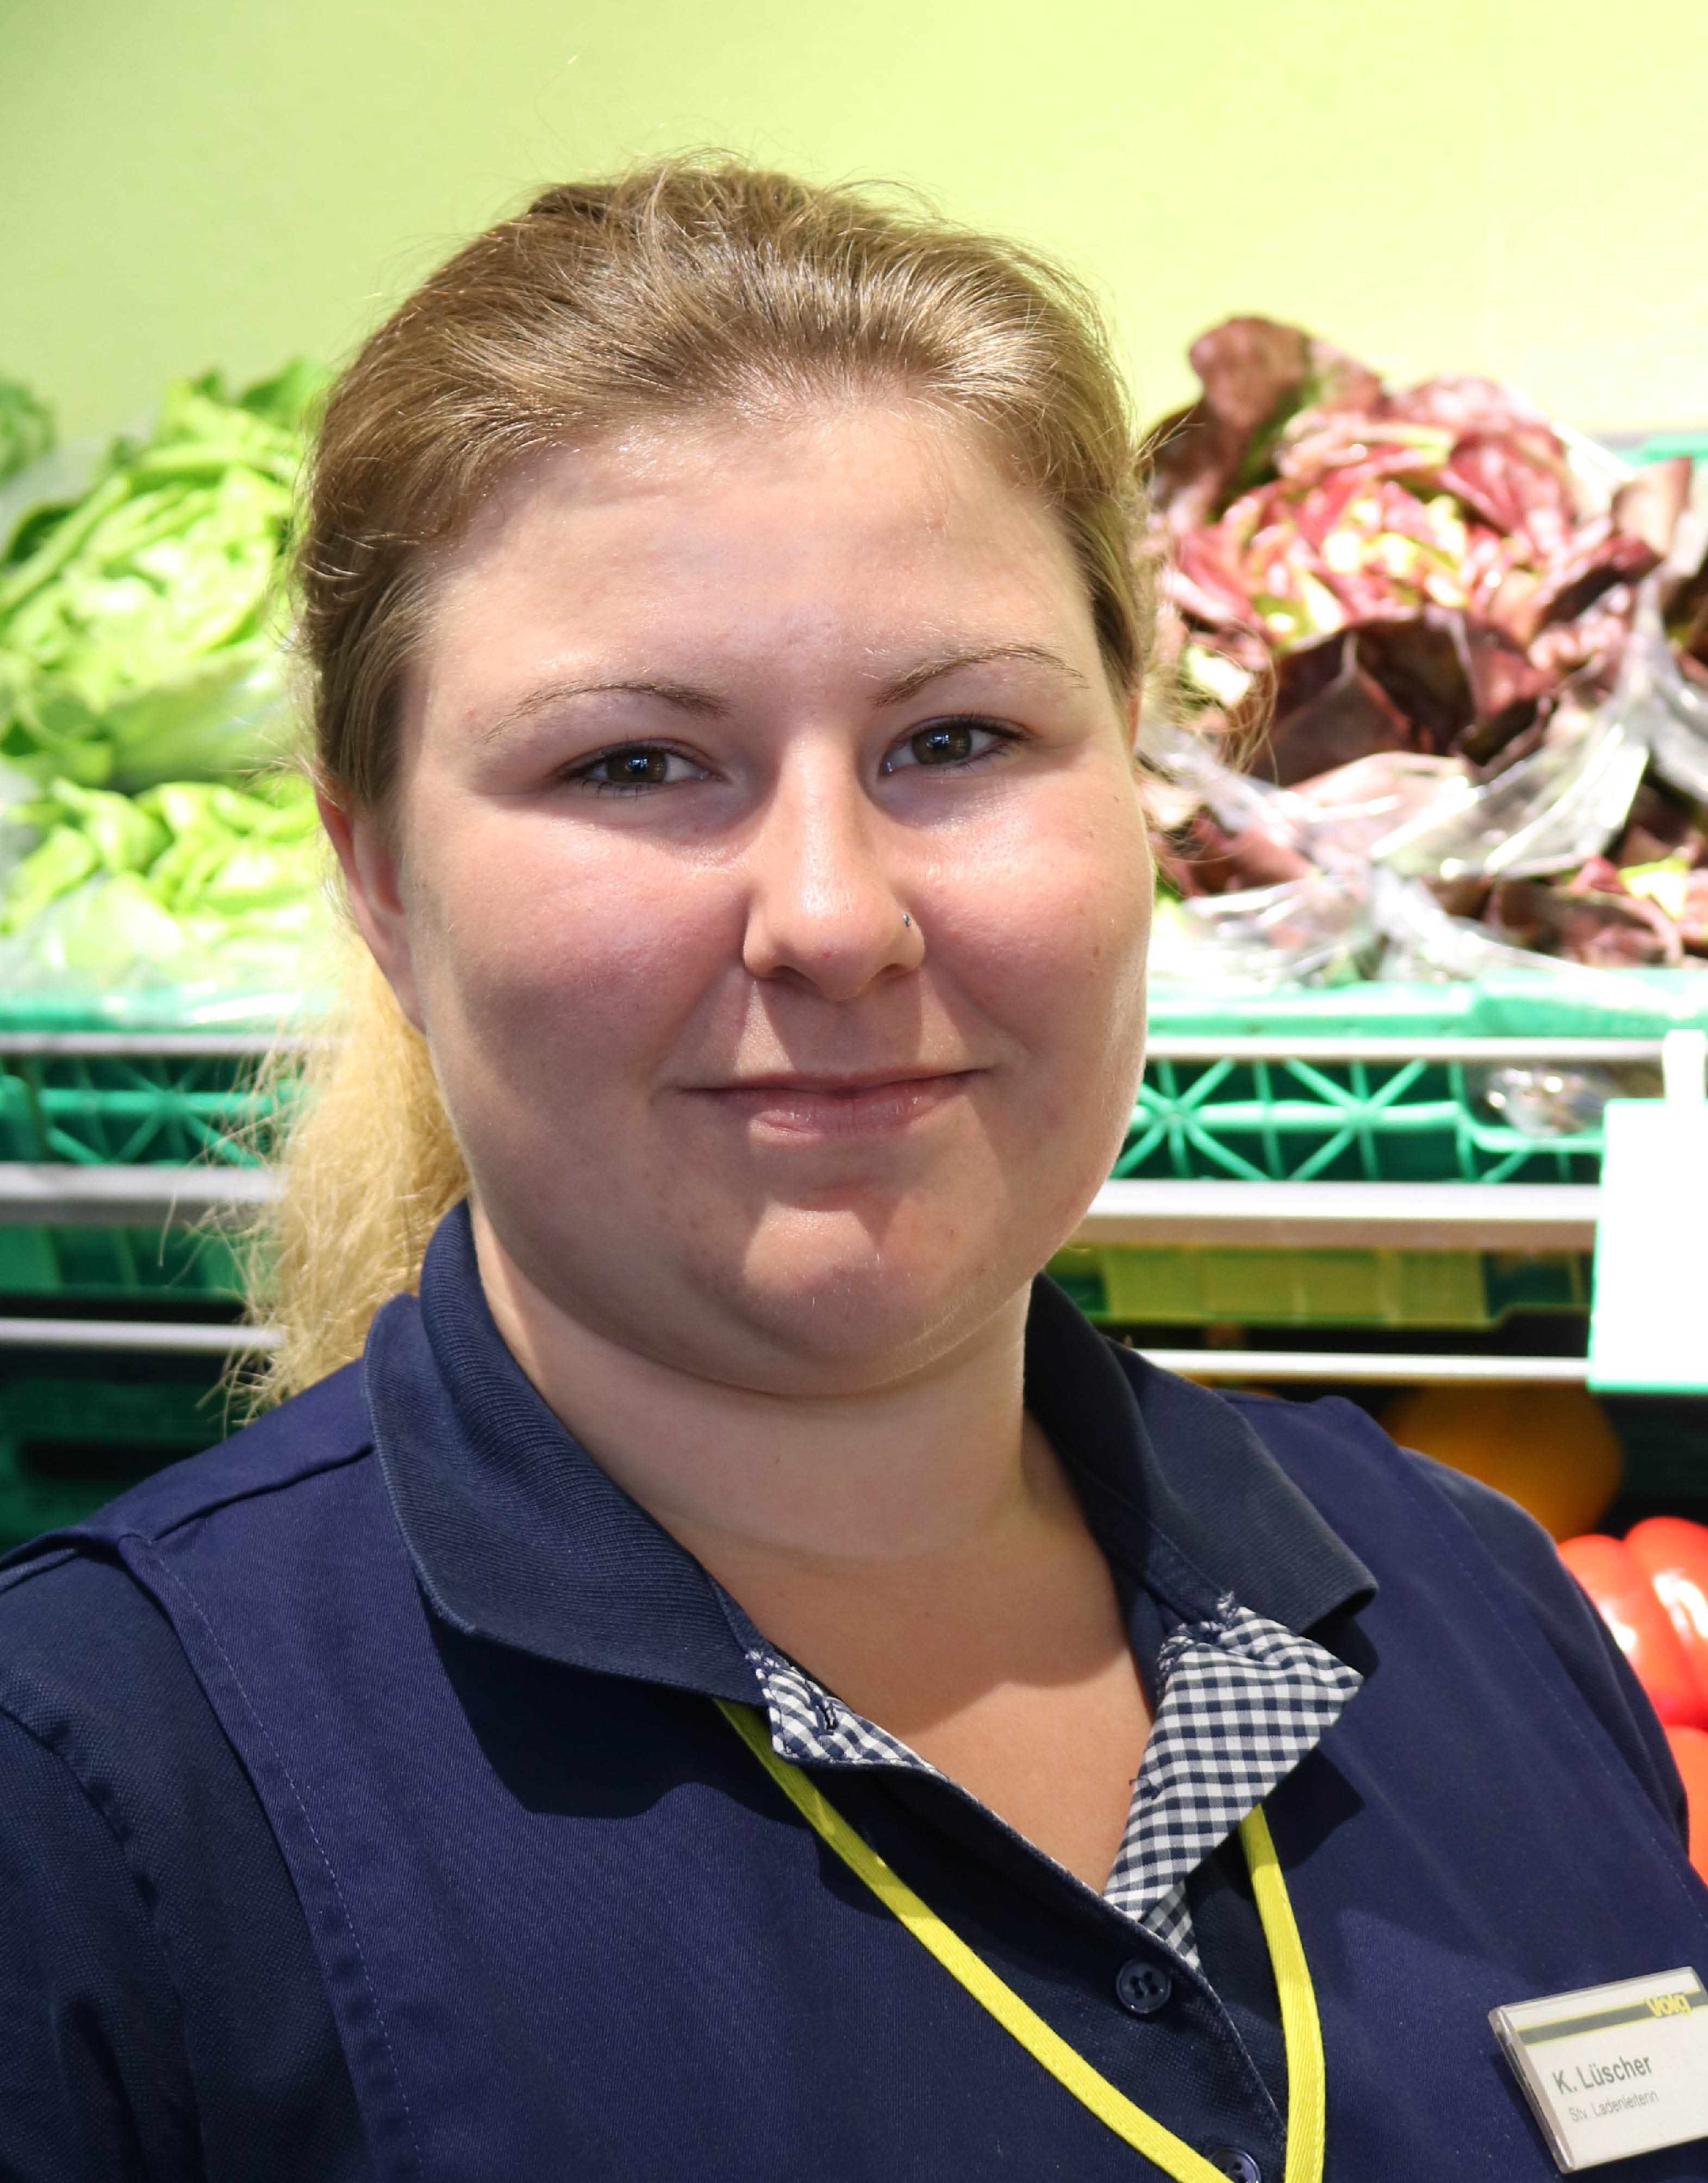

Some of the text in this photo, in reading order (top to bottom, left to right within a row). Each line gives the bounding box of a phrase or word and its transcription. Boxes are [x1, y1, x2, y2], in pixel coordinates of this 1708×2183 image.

[1552, 2056, 1652, 2094] K. Lüscher
[1591, 2091, 1659, 2117] Ladenleiterin
